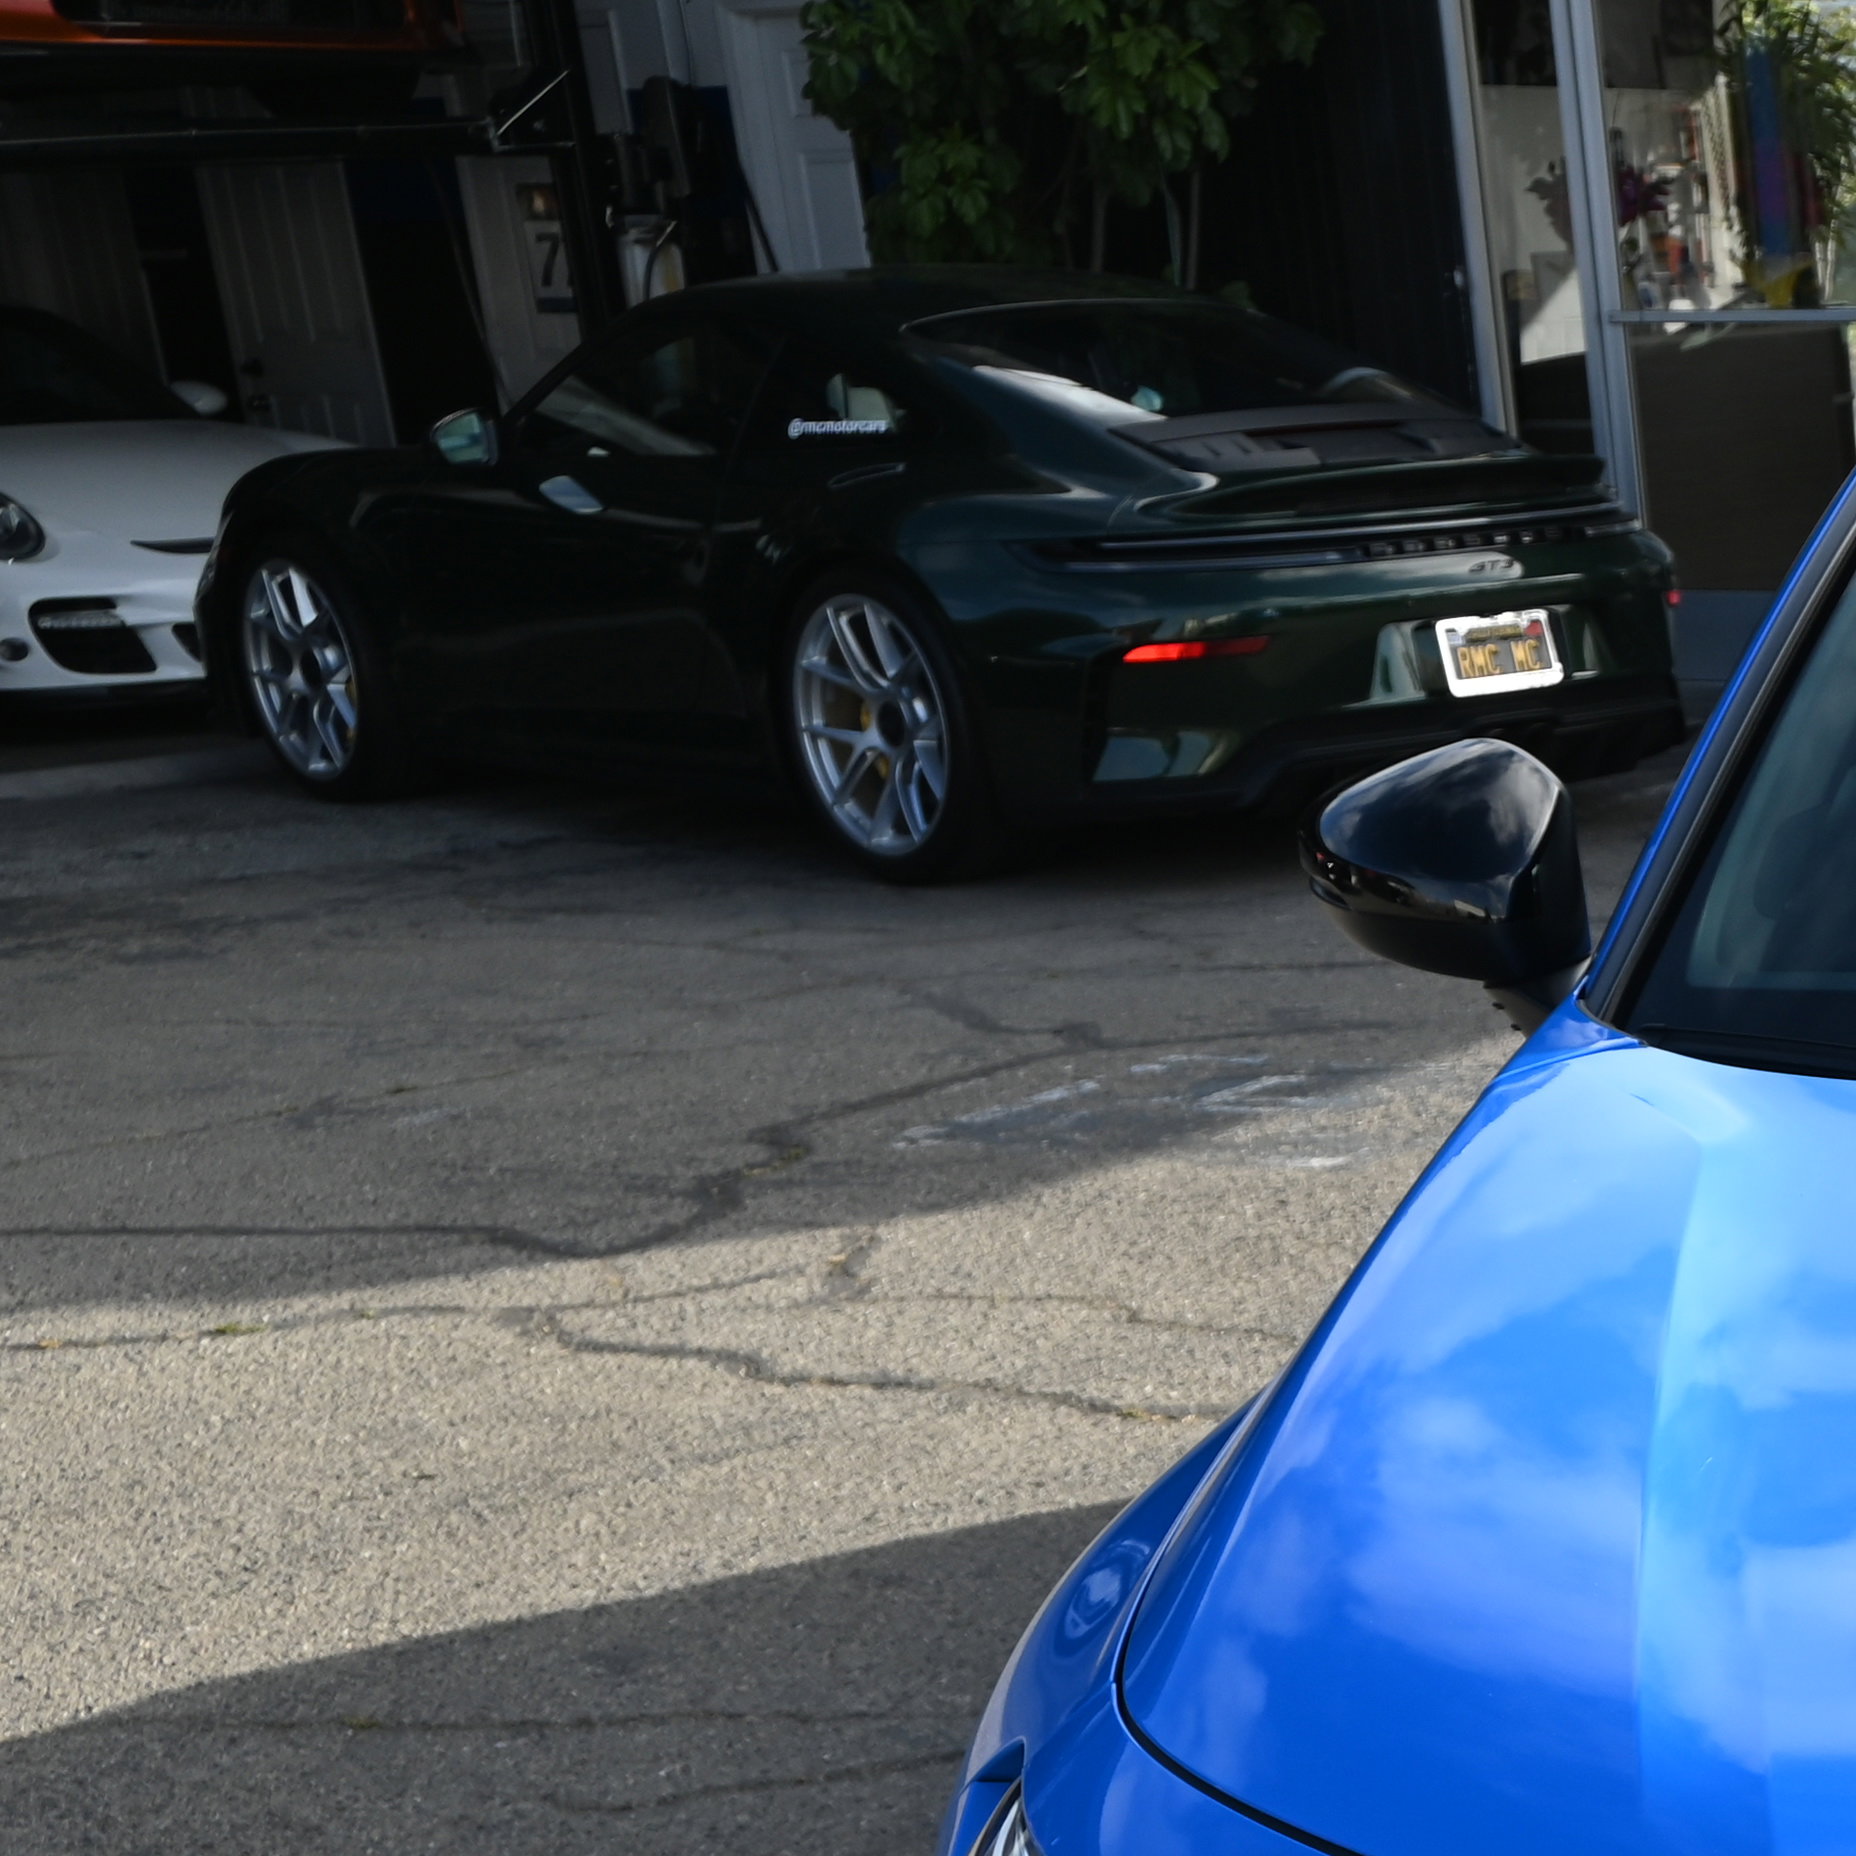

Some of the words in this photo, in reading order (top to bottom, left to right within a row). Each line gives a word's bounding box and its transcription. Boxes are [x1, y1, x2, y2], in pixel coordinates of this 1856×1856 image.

[787, 417, 888, 440] @mcmotorcars
[1457, 643, 1501, 678] RMC
[1510, 639, 1541, 671] MC
